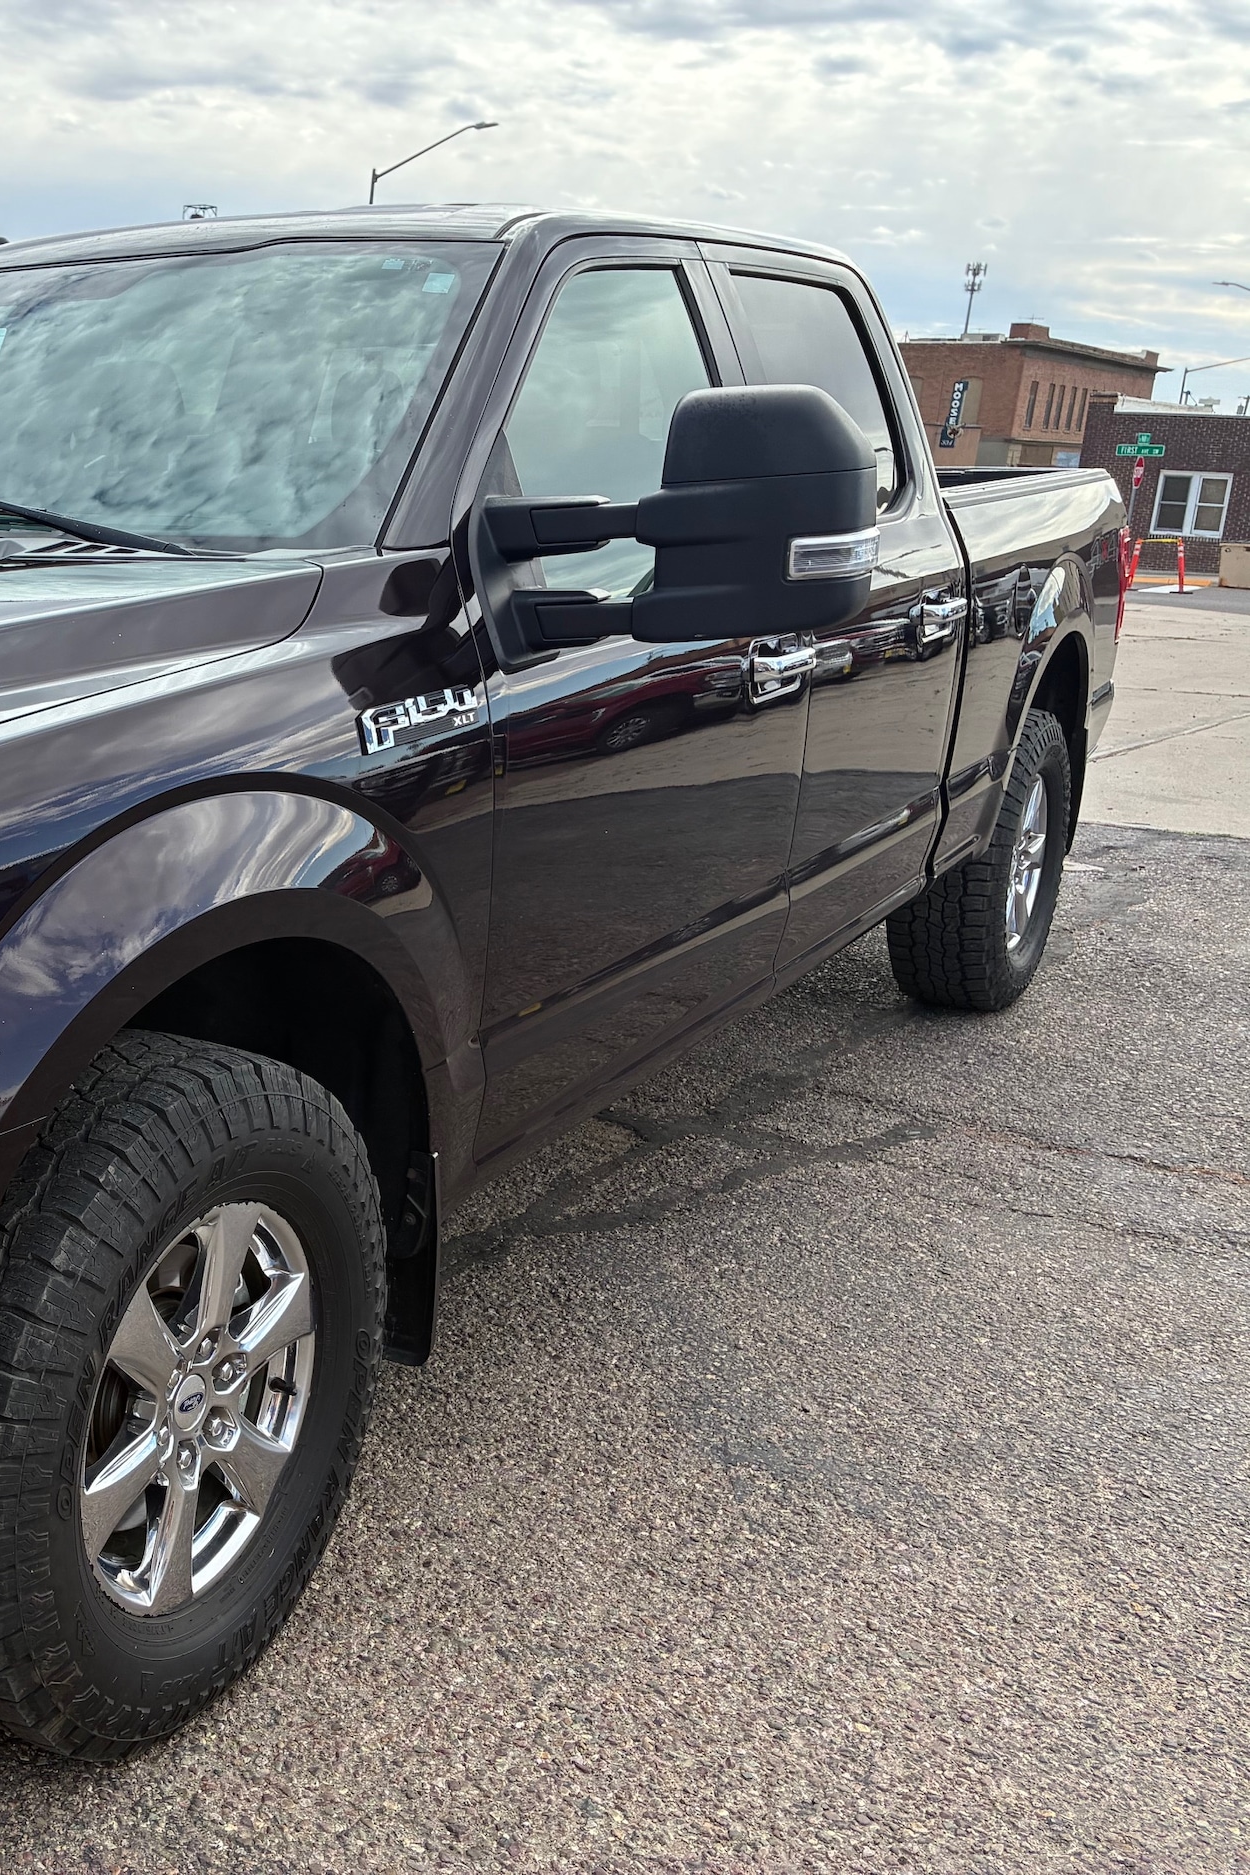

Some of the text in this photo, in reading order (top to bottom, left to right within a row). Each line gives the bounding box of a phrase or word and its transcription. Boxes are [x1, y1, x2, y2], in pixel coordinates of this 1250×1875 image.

[948, 382, 964, 427] MOOSE
[1120, 446, 1139, 455] FIRST
[453, 711, 476, 727] XLT
[57, 1355, 96, 1522] OPEN
[98, 1176, 199, 1354] RANGE
